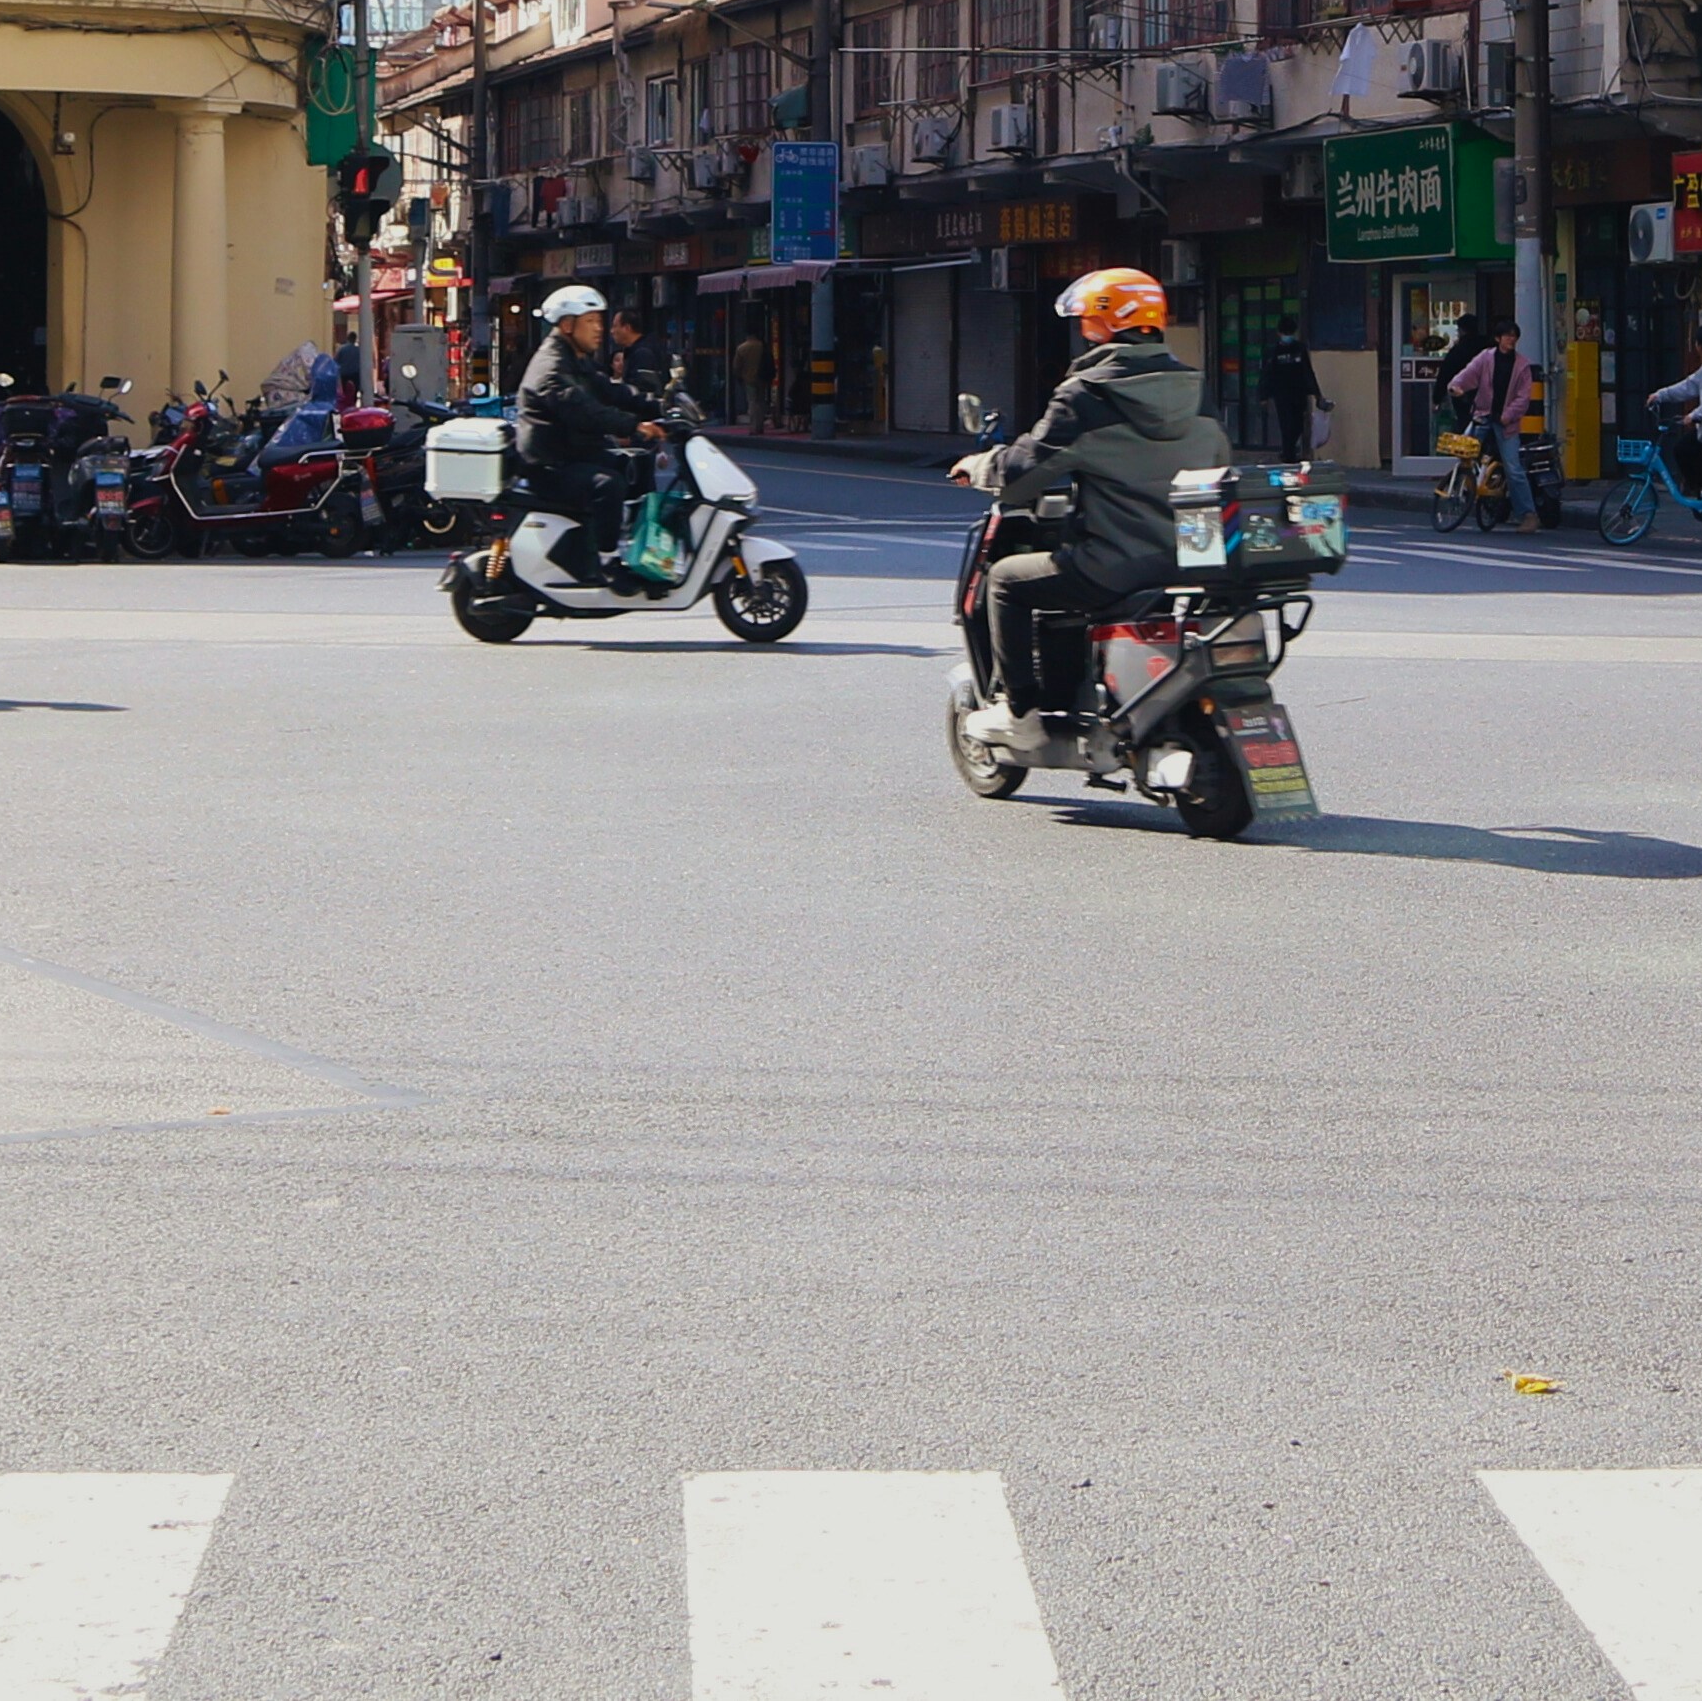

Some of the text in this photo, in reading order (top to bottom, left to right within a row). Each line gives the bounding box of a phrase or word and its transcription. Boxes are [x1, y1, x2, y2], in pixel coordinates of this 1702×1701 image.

[1335, 164, 1442, 219] 兰州牛肉面
